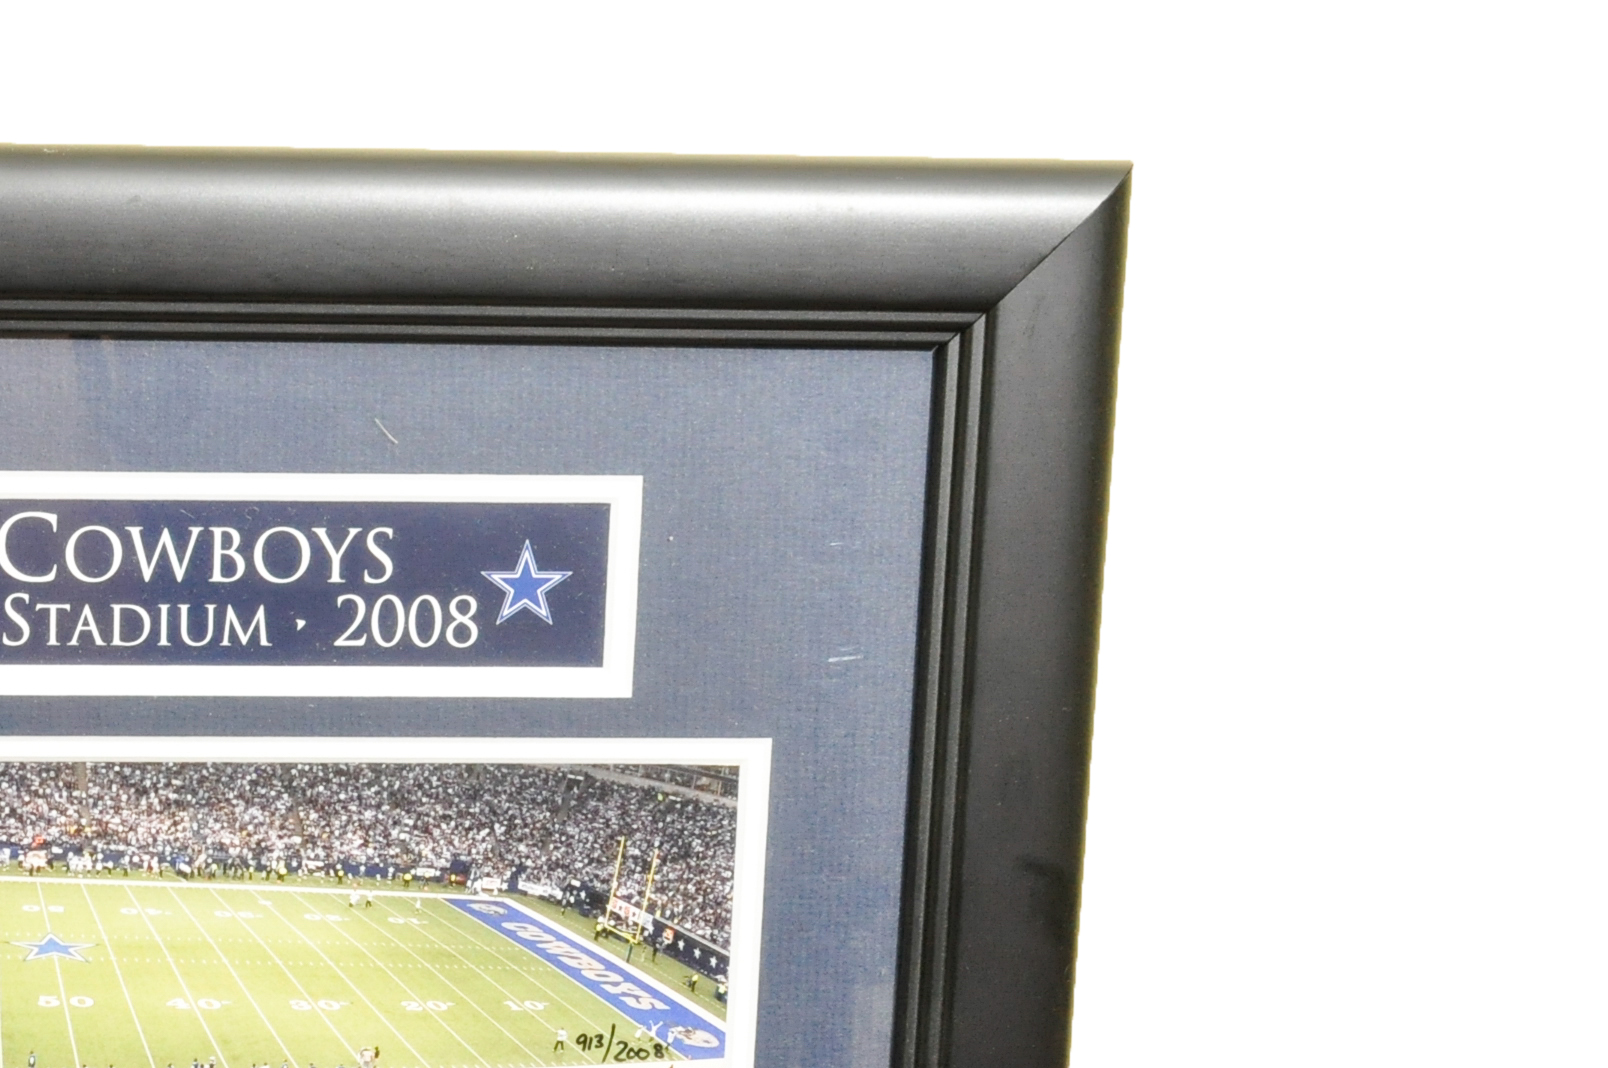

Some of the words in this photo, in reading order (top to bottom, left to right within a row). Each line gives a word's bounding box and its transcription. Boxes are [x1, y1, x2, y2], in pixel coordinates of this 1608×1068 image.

[2, 592, 273, 647] STADIUM
[333, 593, 479, 649] 2008
[501, 922, 671, 1010] COWBOYS
